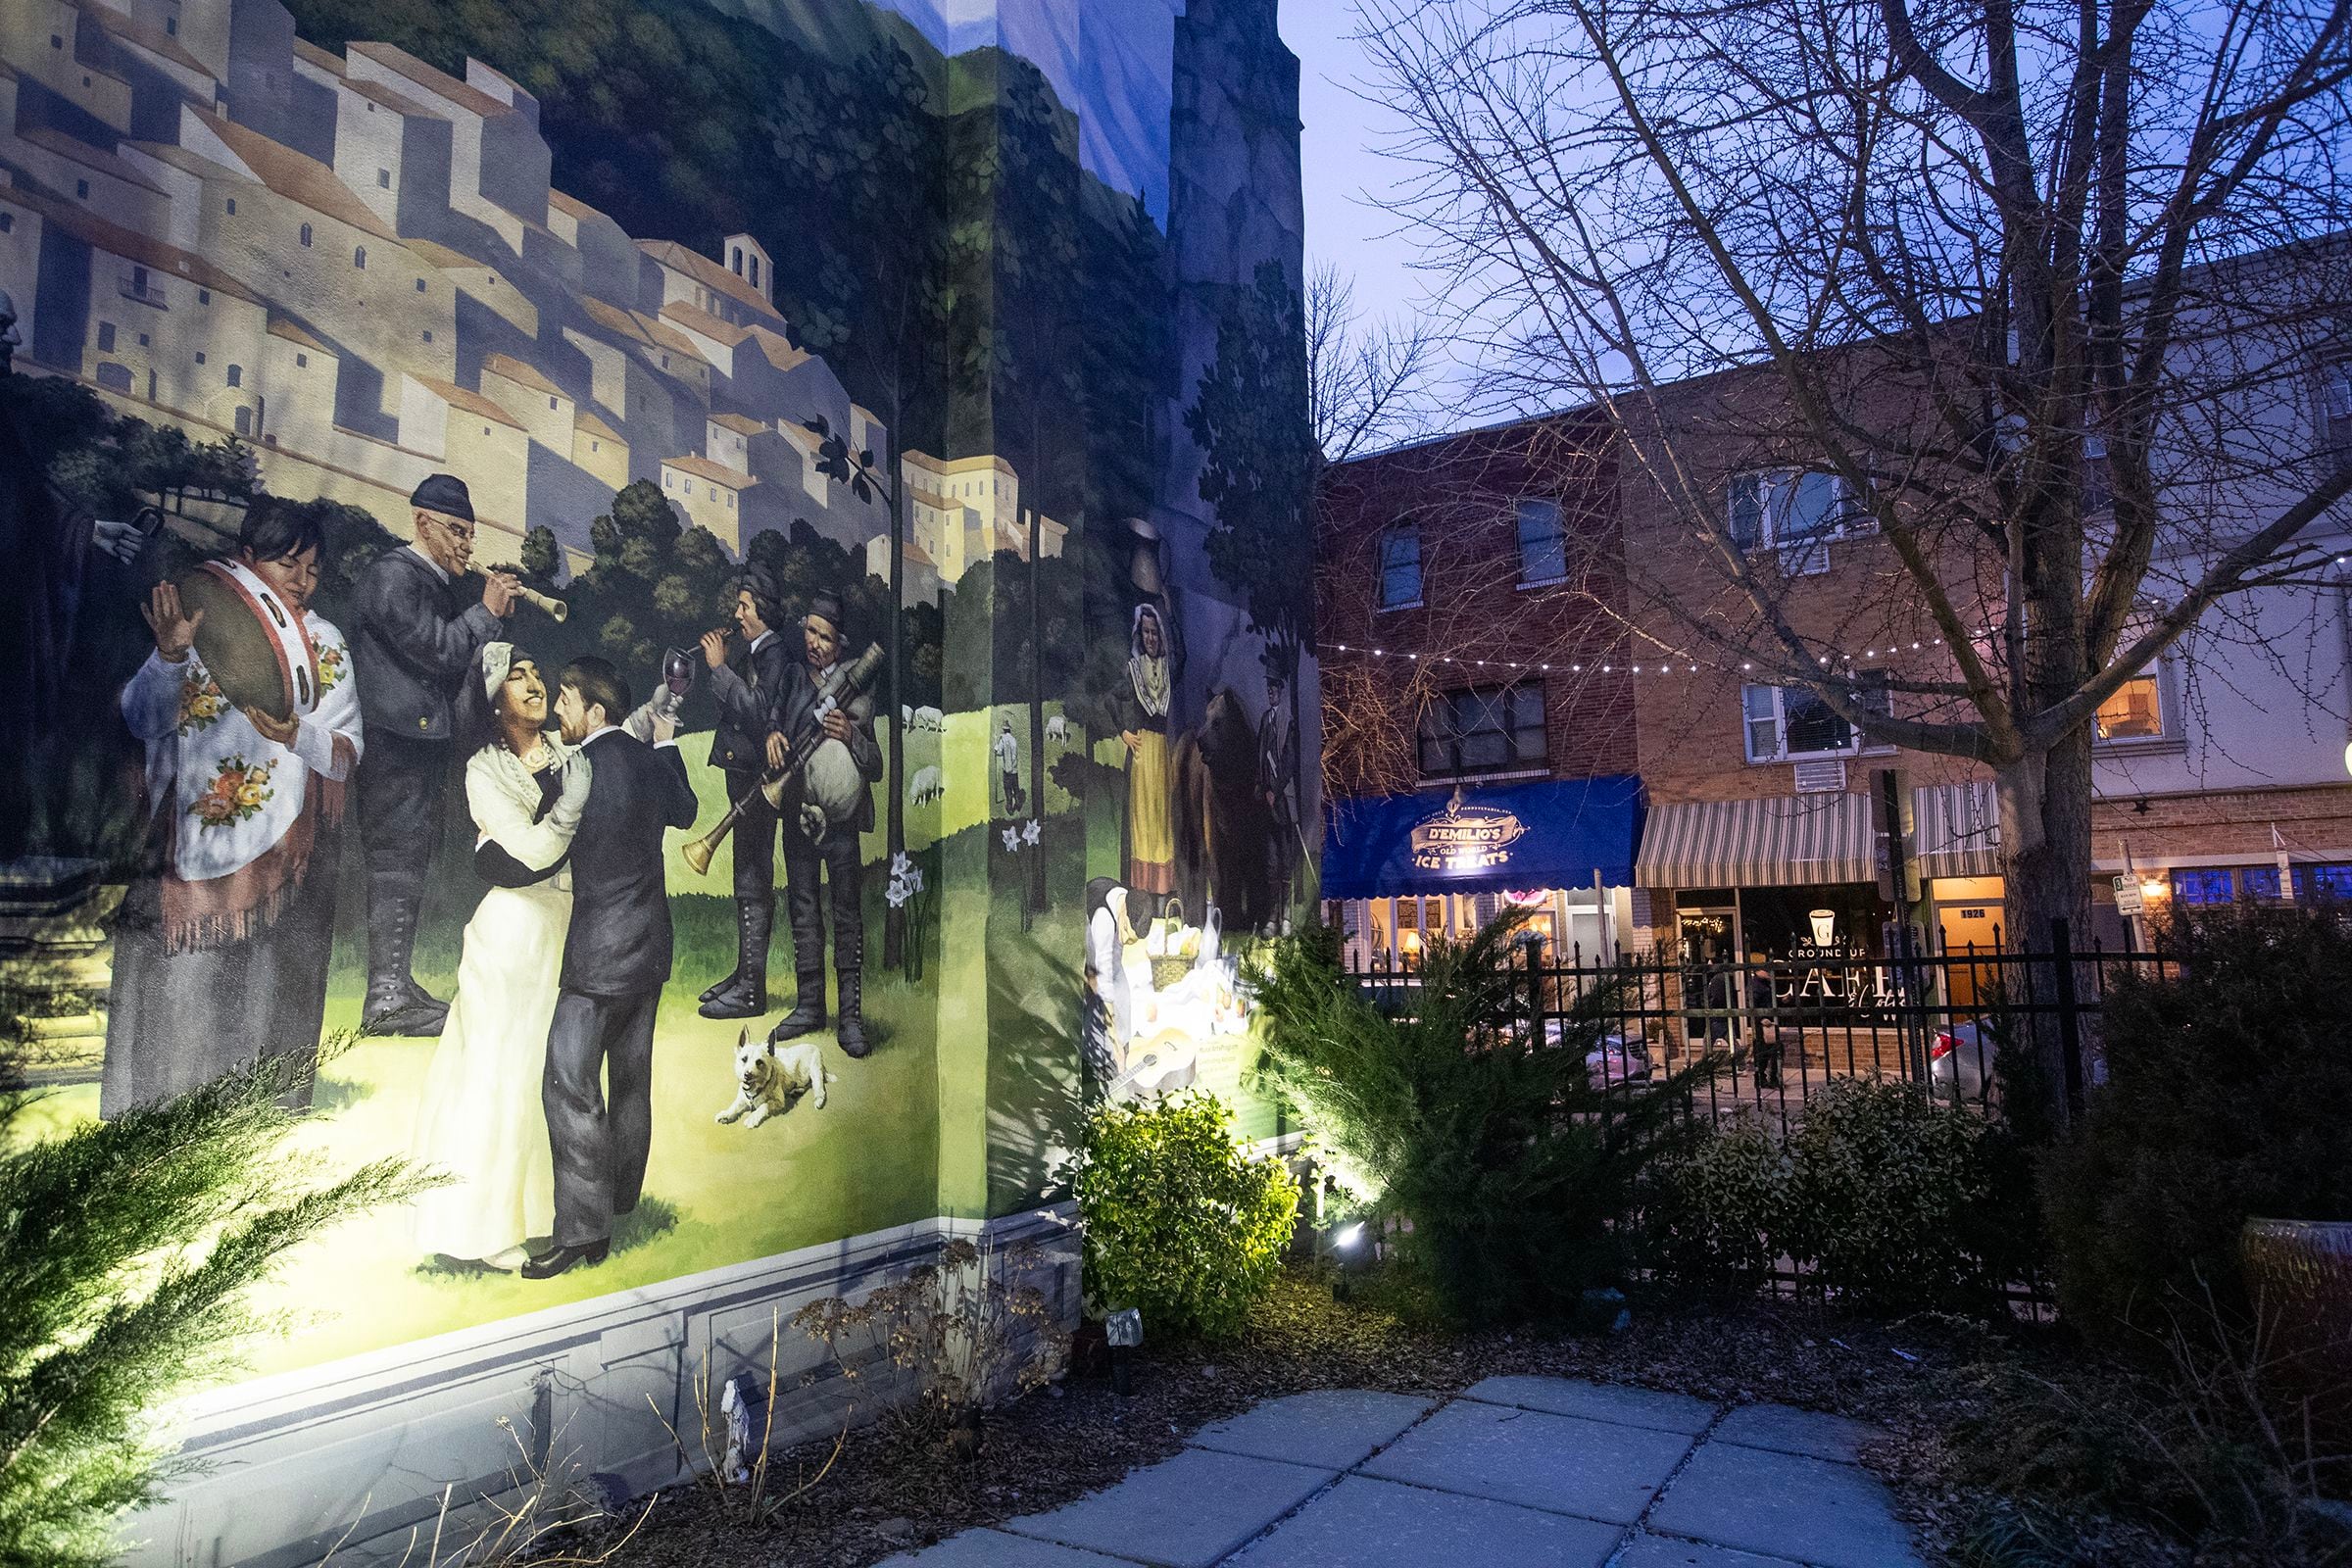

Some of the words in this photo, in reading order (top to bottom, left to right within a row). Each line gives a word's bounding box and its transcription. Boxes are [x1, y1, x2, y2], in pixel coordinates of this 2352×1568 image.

[1428, 828, 1500, 841] D'EMILIO'S
[1440, 847, 1456, 856] OLD
[1457, 845, 1488, 855] WORLD
[1414, 855, 1442, 869] ICE
[1446, 850, 1509, 870] TREATS
[1961, 908, 1985, 919] 1926
[1817, 923, 1831, 940] G
